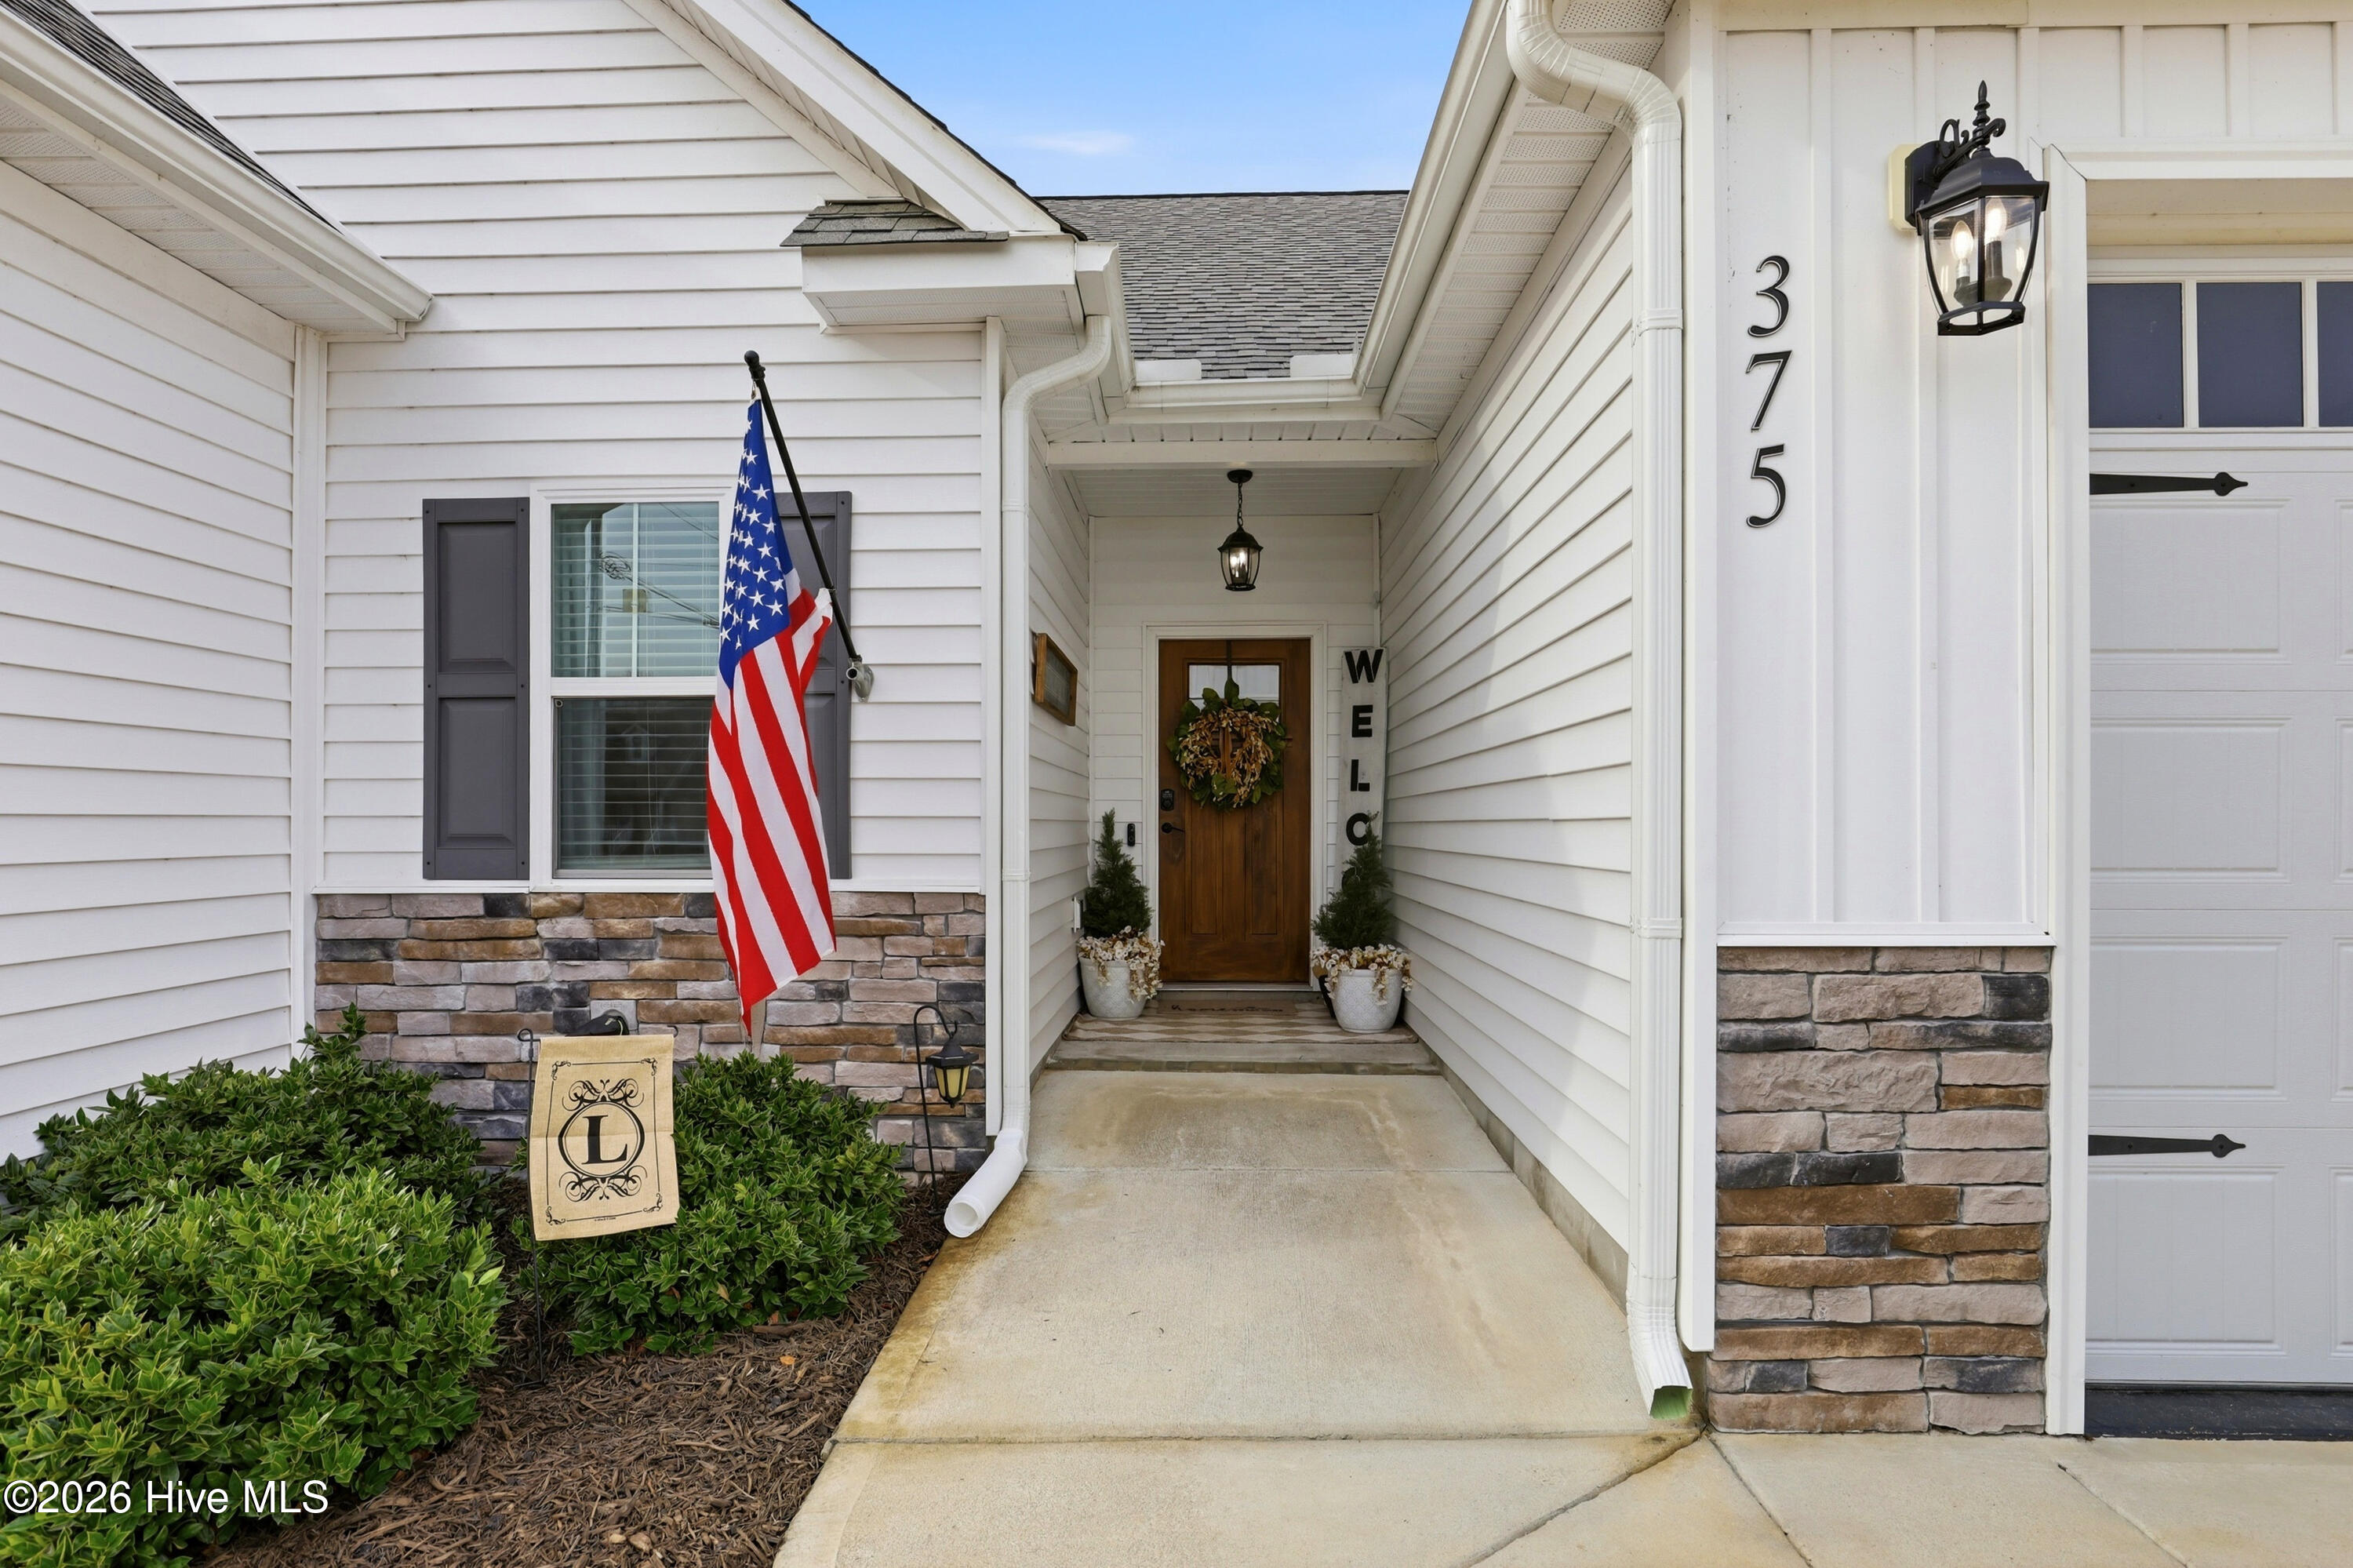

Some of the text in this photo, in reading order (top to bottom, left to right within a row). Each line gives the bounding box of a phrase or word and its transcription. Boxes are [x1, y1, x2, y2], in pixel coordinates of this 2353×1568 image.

[1745, 255, 1793, 529] 375
[1340, 648, 1384, 890] WELC
[581, 1115, 628, 1165] L
